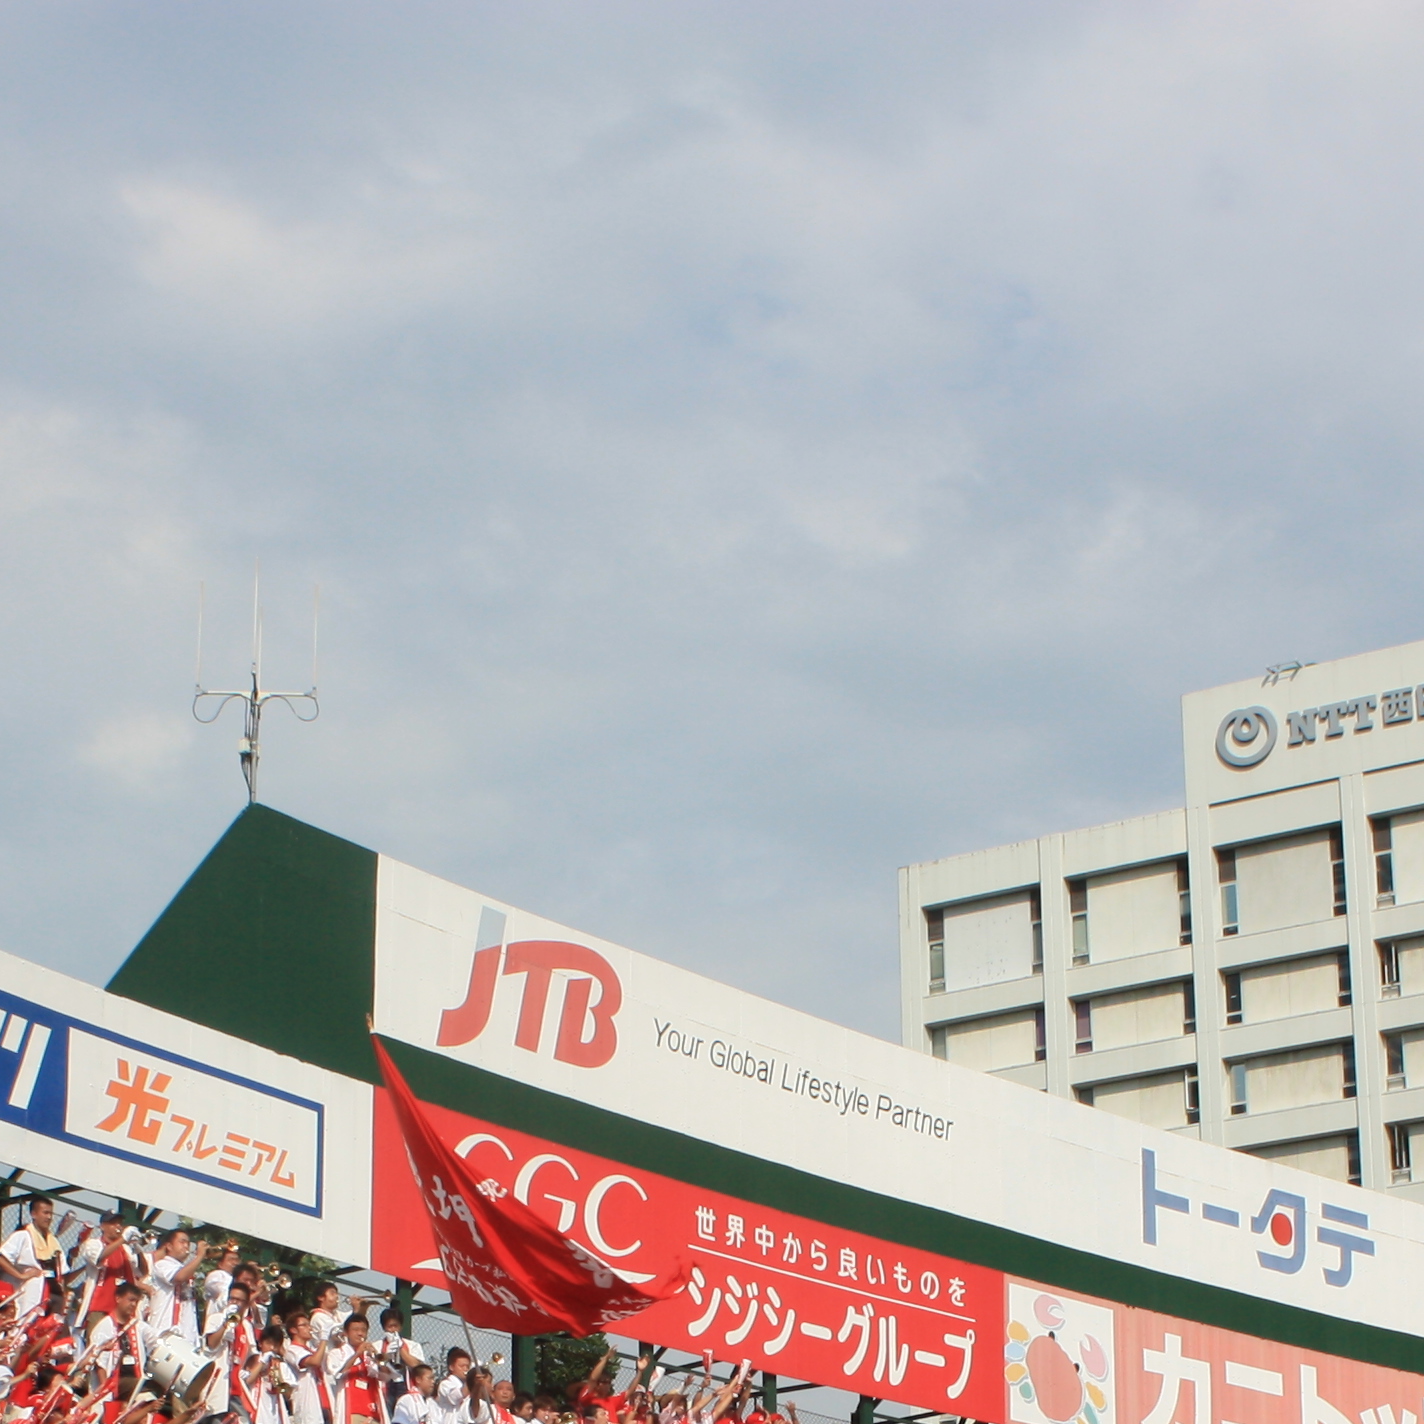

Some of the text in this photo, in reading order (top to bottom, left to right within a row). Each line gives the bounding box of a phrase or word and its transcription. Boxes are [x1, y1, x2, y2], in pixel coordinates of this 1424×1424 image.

[436, 905, 622, 1068] JTB
[95, 1057, 297, 1188] 光プレミアム
[653, 1018, 953, 1141] Your Global Lifestyle Partner
[695, 1205, 968, 1307] 世界中から良いものを
[1141, 1147, 1375, 1287] トータテ
[686, 1266, 977, 1400] シジシーグループ
